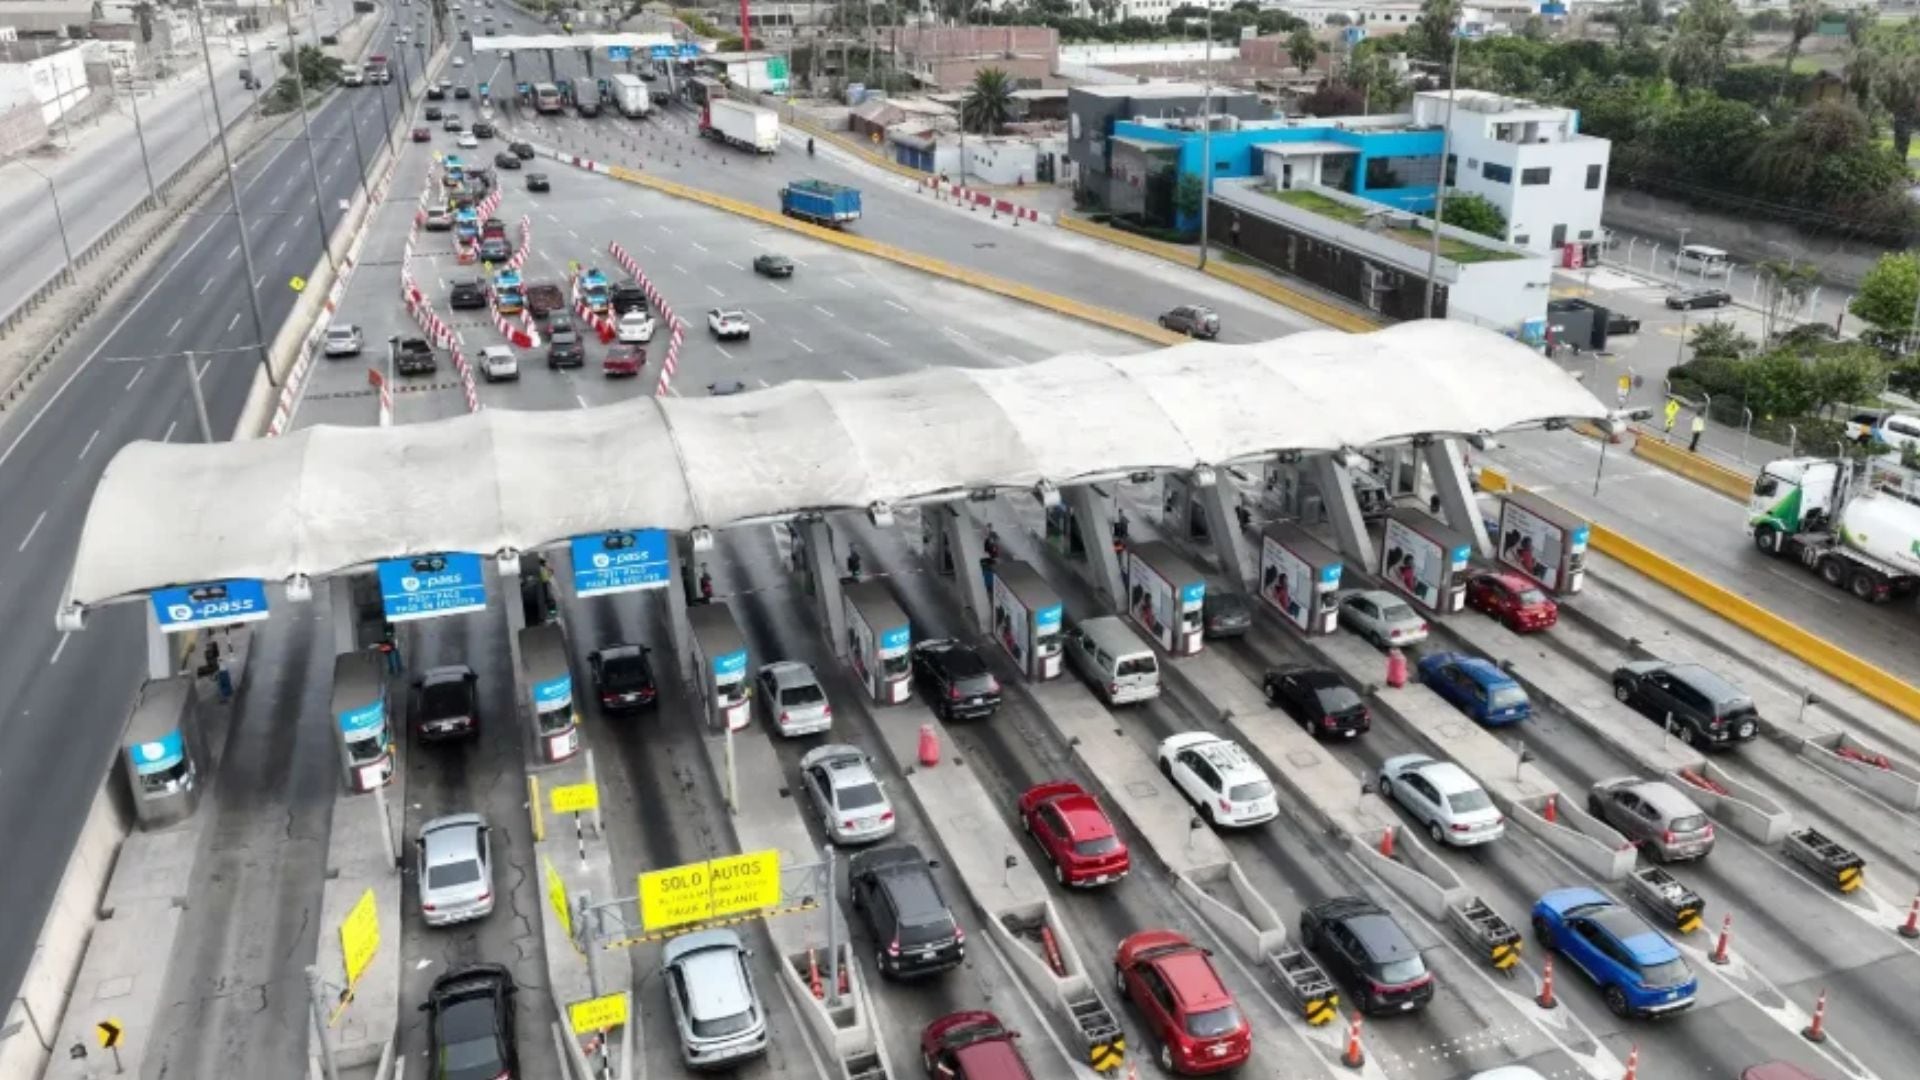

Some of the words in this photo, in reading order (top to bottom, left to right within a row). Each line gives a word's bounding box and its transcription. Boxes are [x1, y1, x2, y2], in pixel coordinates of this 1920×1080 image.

[168, 598, 254, 620] e-pass
[660, 871, 702, 893] SOLO
[711, 860, 762, 882] AUTOS
